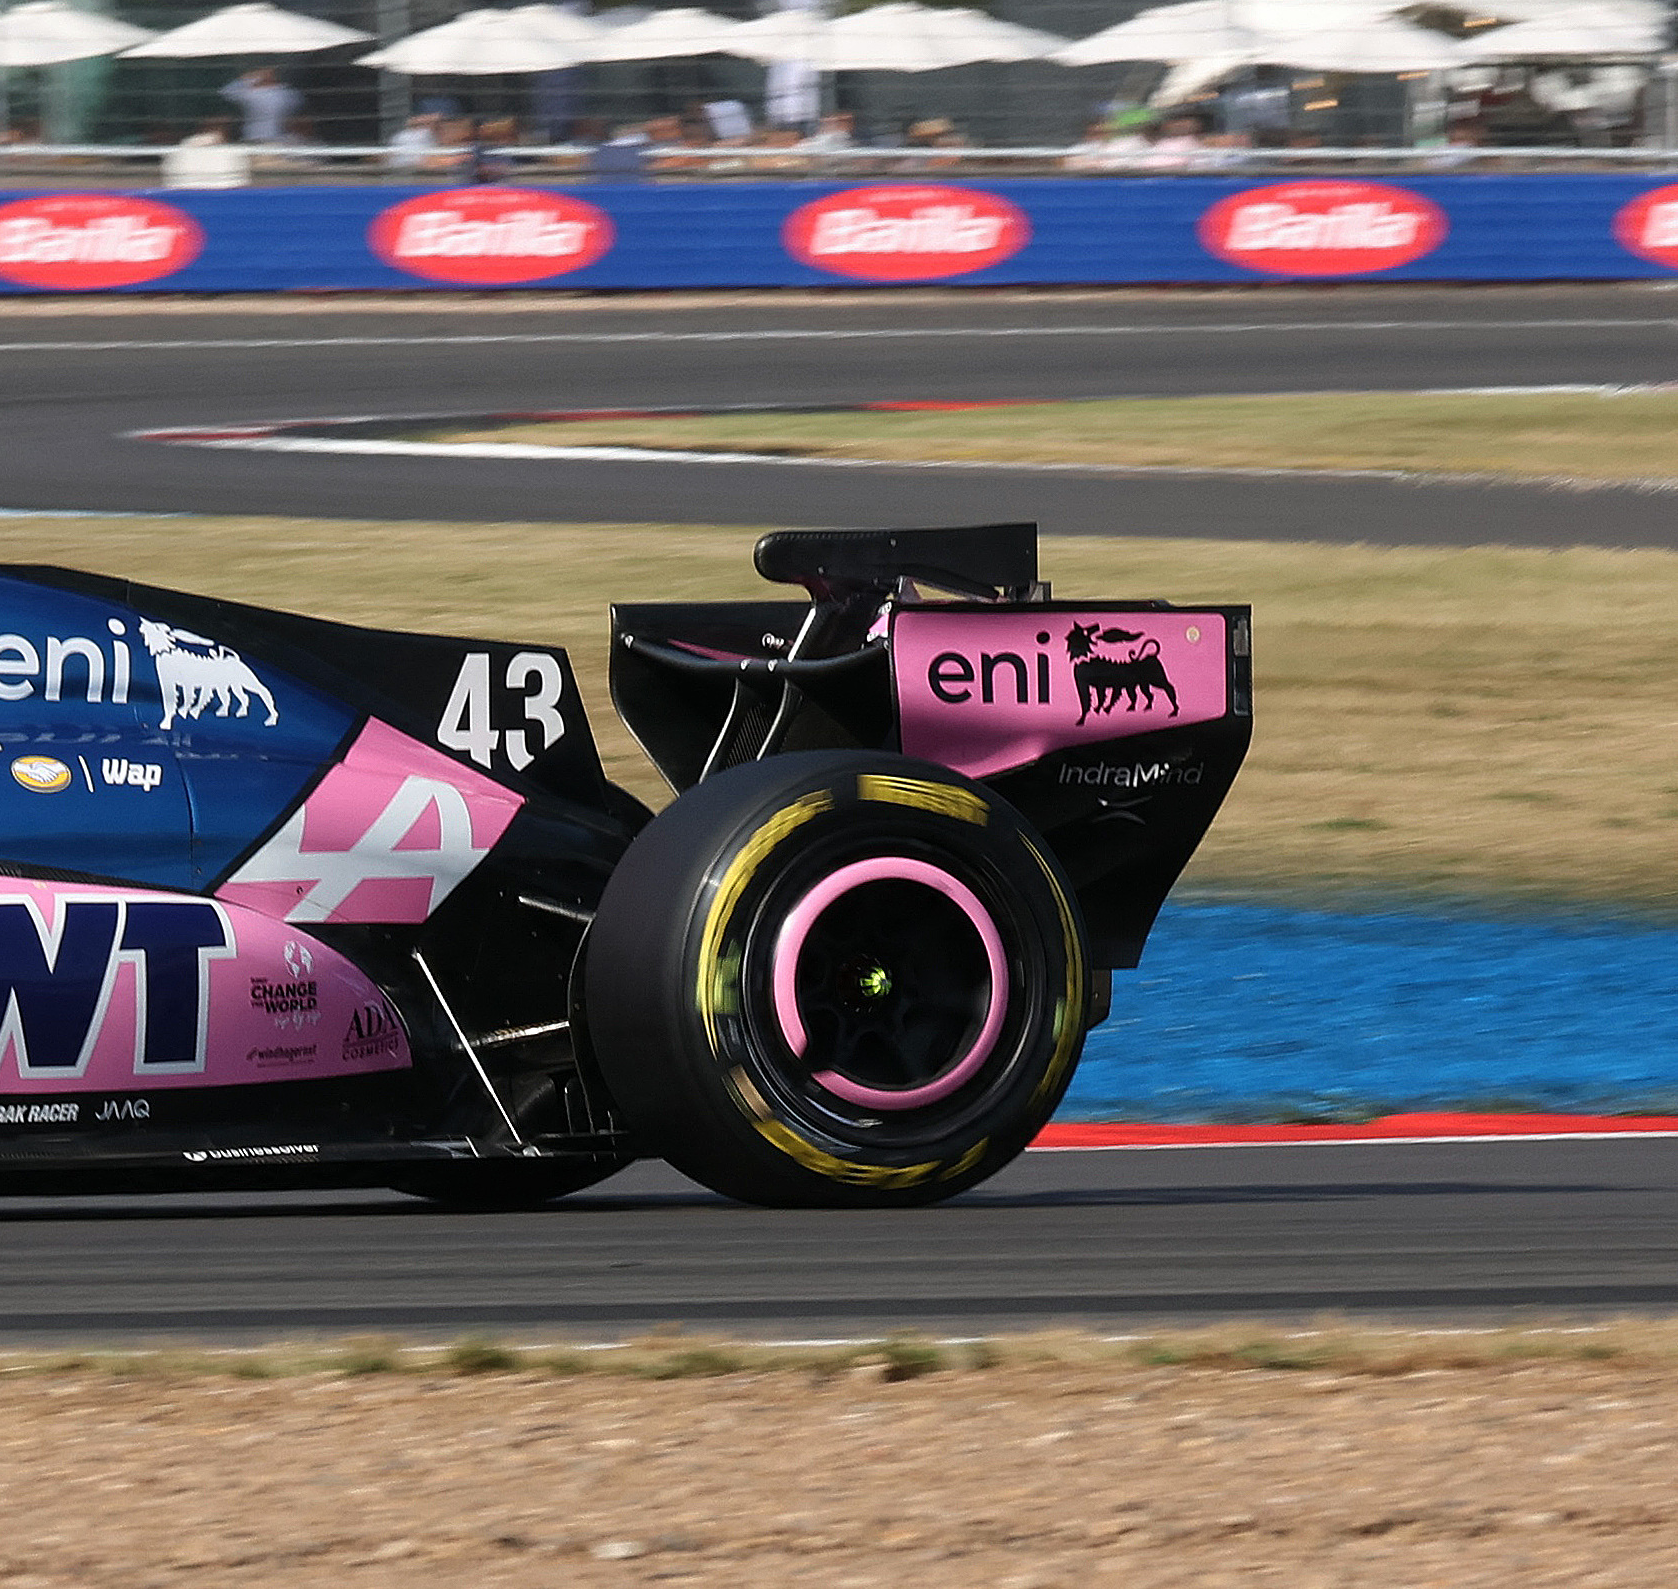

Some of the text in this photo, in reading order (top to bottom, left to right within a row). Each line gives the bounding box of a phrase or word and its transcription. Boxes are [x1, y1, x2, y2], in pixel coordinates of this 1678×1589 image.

[927, 631, 1051, 704] eni
[437, 652, 565, 771] 43
[102, 758, 162, 791] Wap
[251, 981, 317, 999] CHANGE
[264, 997, 318, 1013] WORLD
[27, 1103, 80, 1123] RACER
